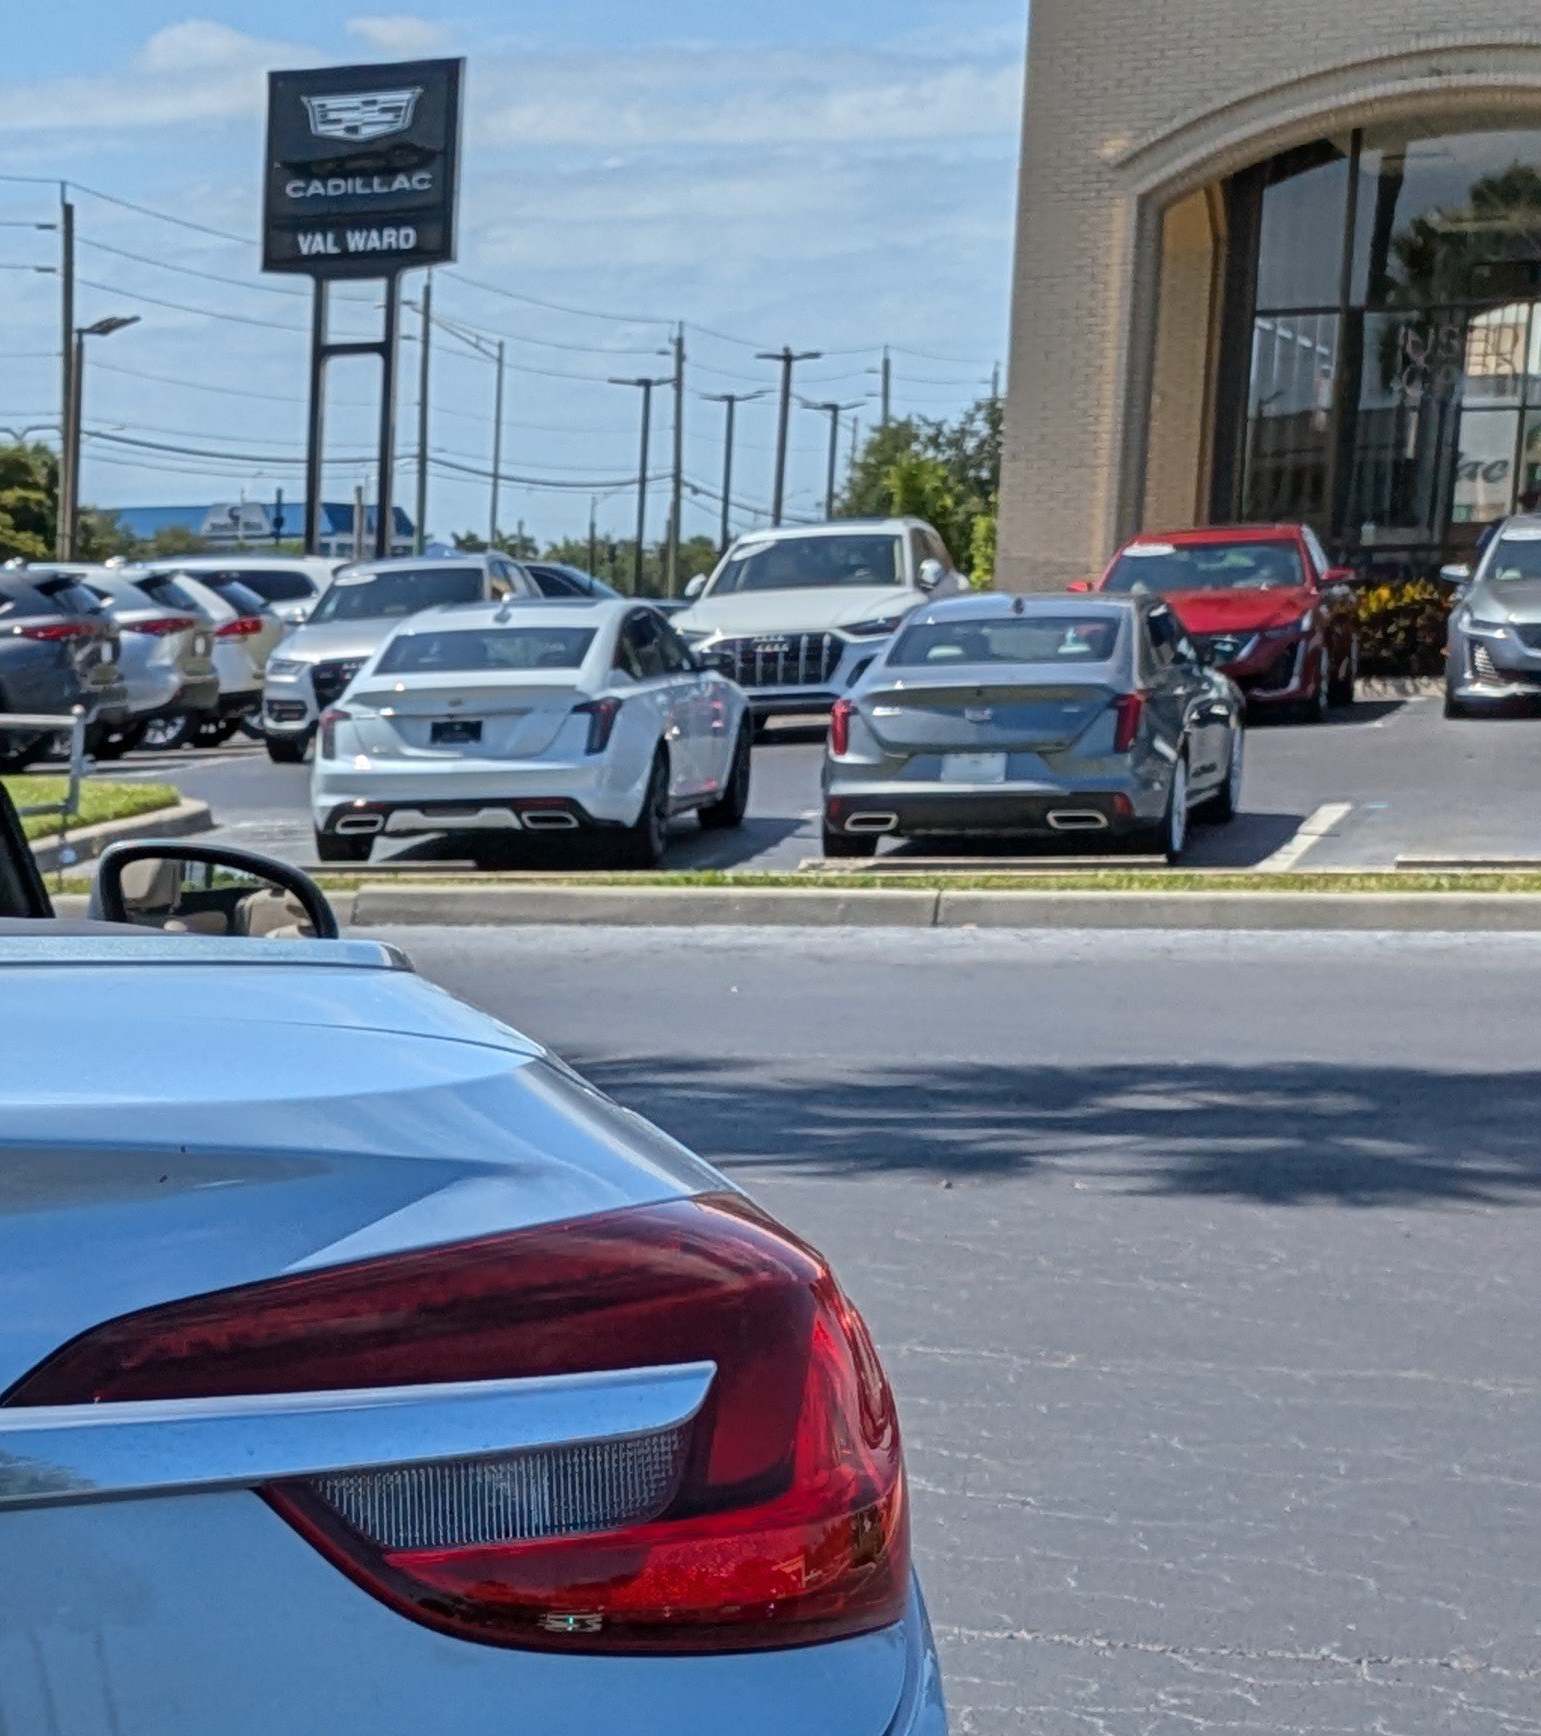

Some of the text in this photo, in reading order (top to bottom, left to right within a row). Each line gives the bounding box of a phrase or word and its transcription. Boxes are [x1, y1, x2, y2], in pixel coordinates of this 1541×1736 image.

[285, 171, 433, 199] CADILLAC
[297, 226, 417, 256] VAL WARD
